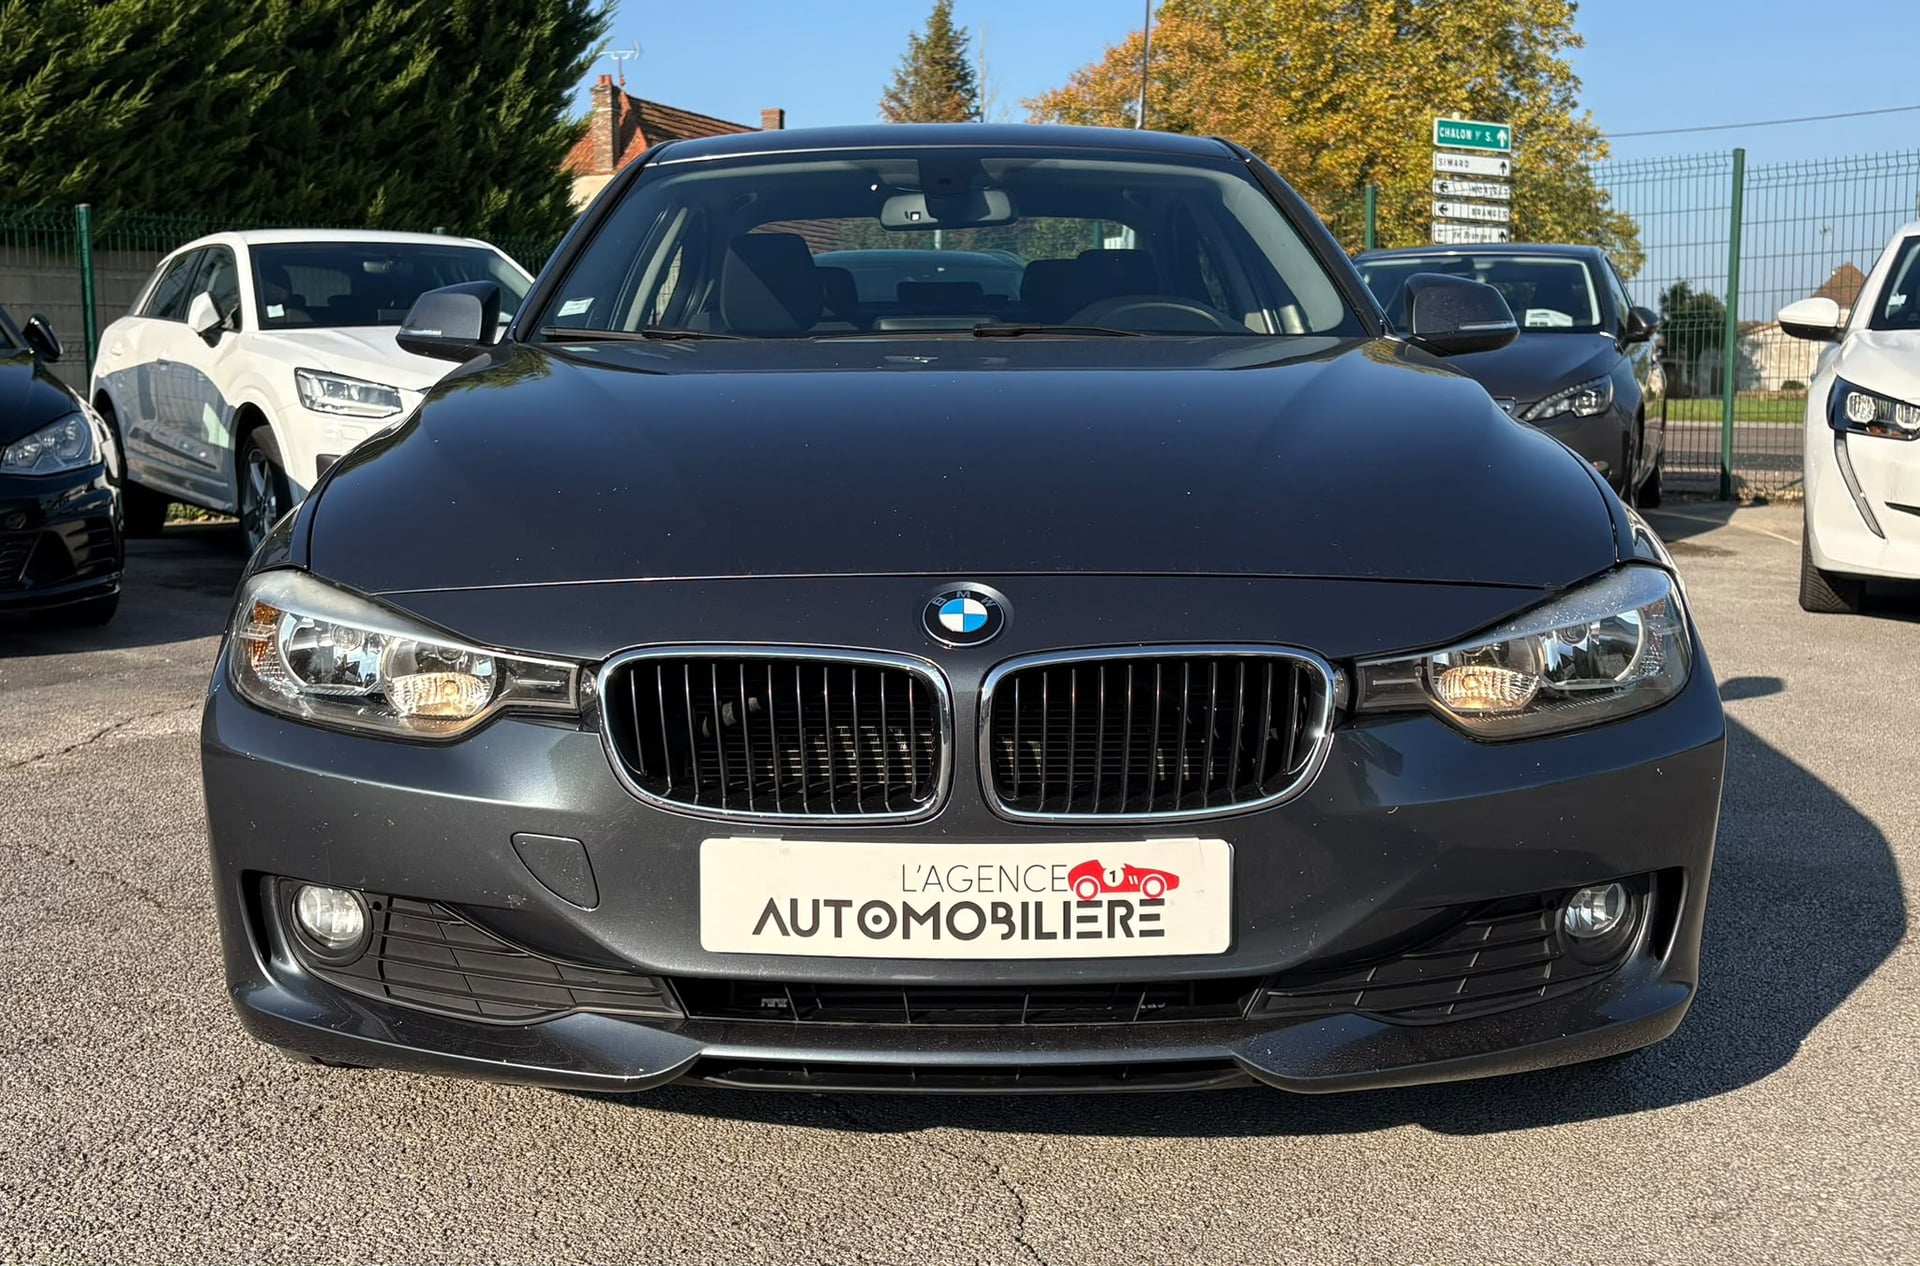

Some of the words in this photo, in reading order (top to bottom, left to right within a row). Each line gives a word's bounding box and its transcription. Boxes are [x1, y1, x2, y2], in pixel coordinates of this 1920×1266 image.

[1439, 127, 1472, 140] CHALON
[931, 590, 997, 607] BMW
[902, 863, 1068, 894] L'AGENCE
[1109, 870, 1116, 883] 1
